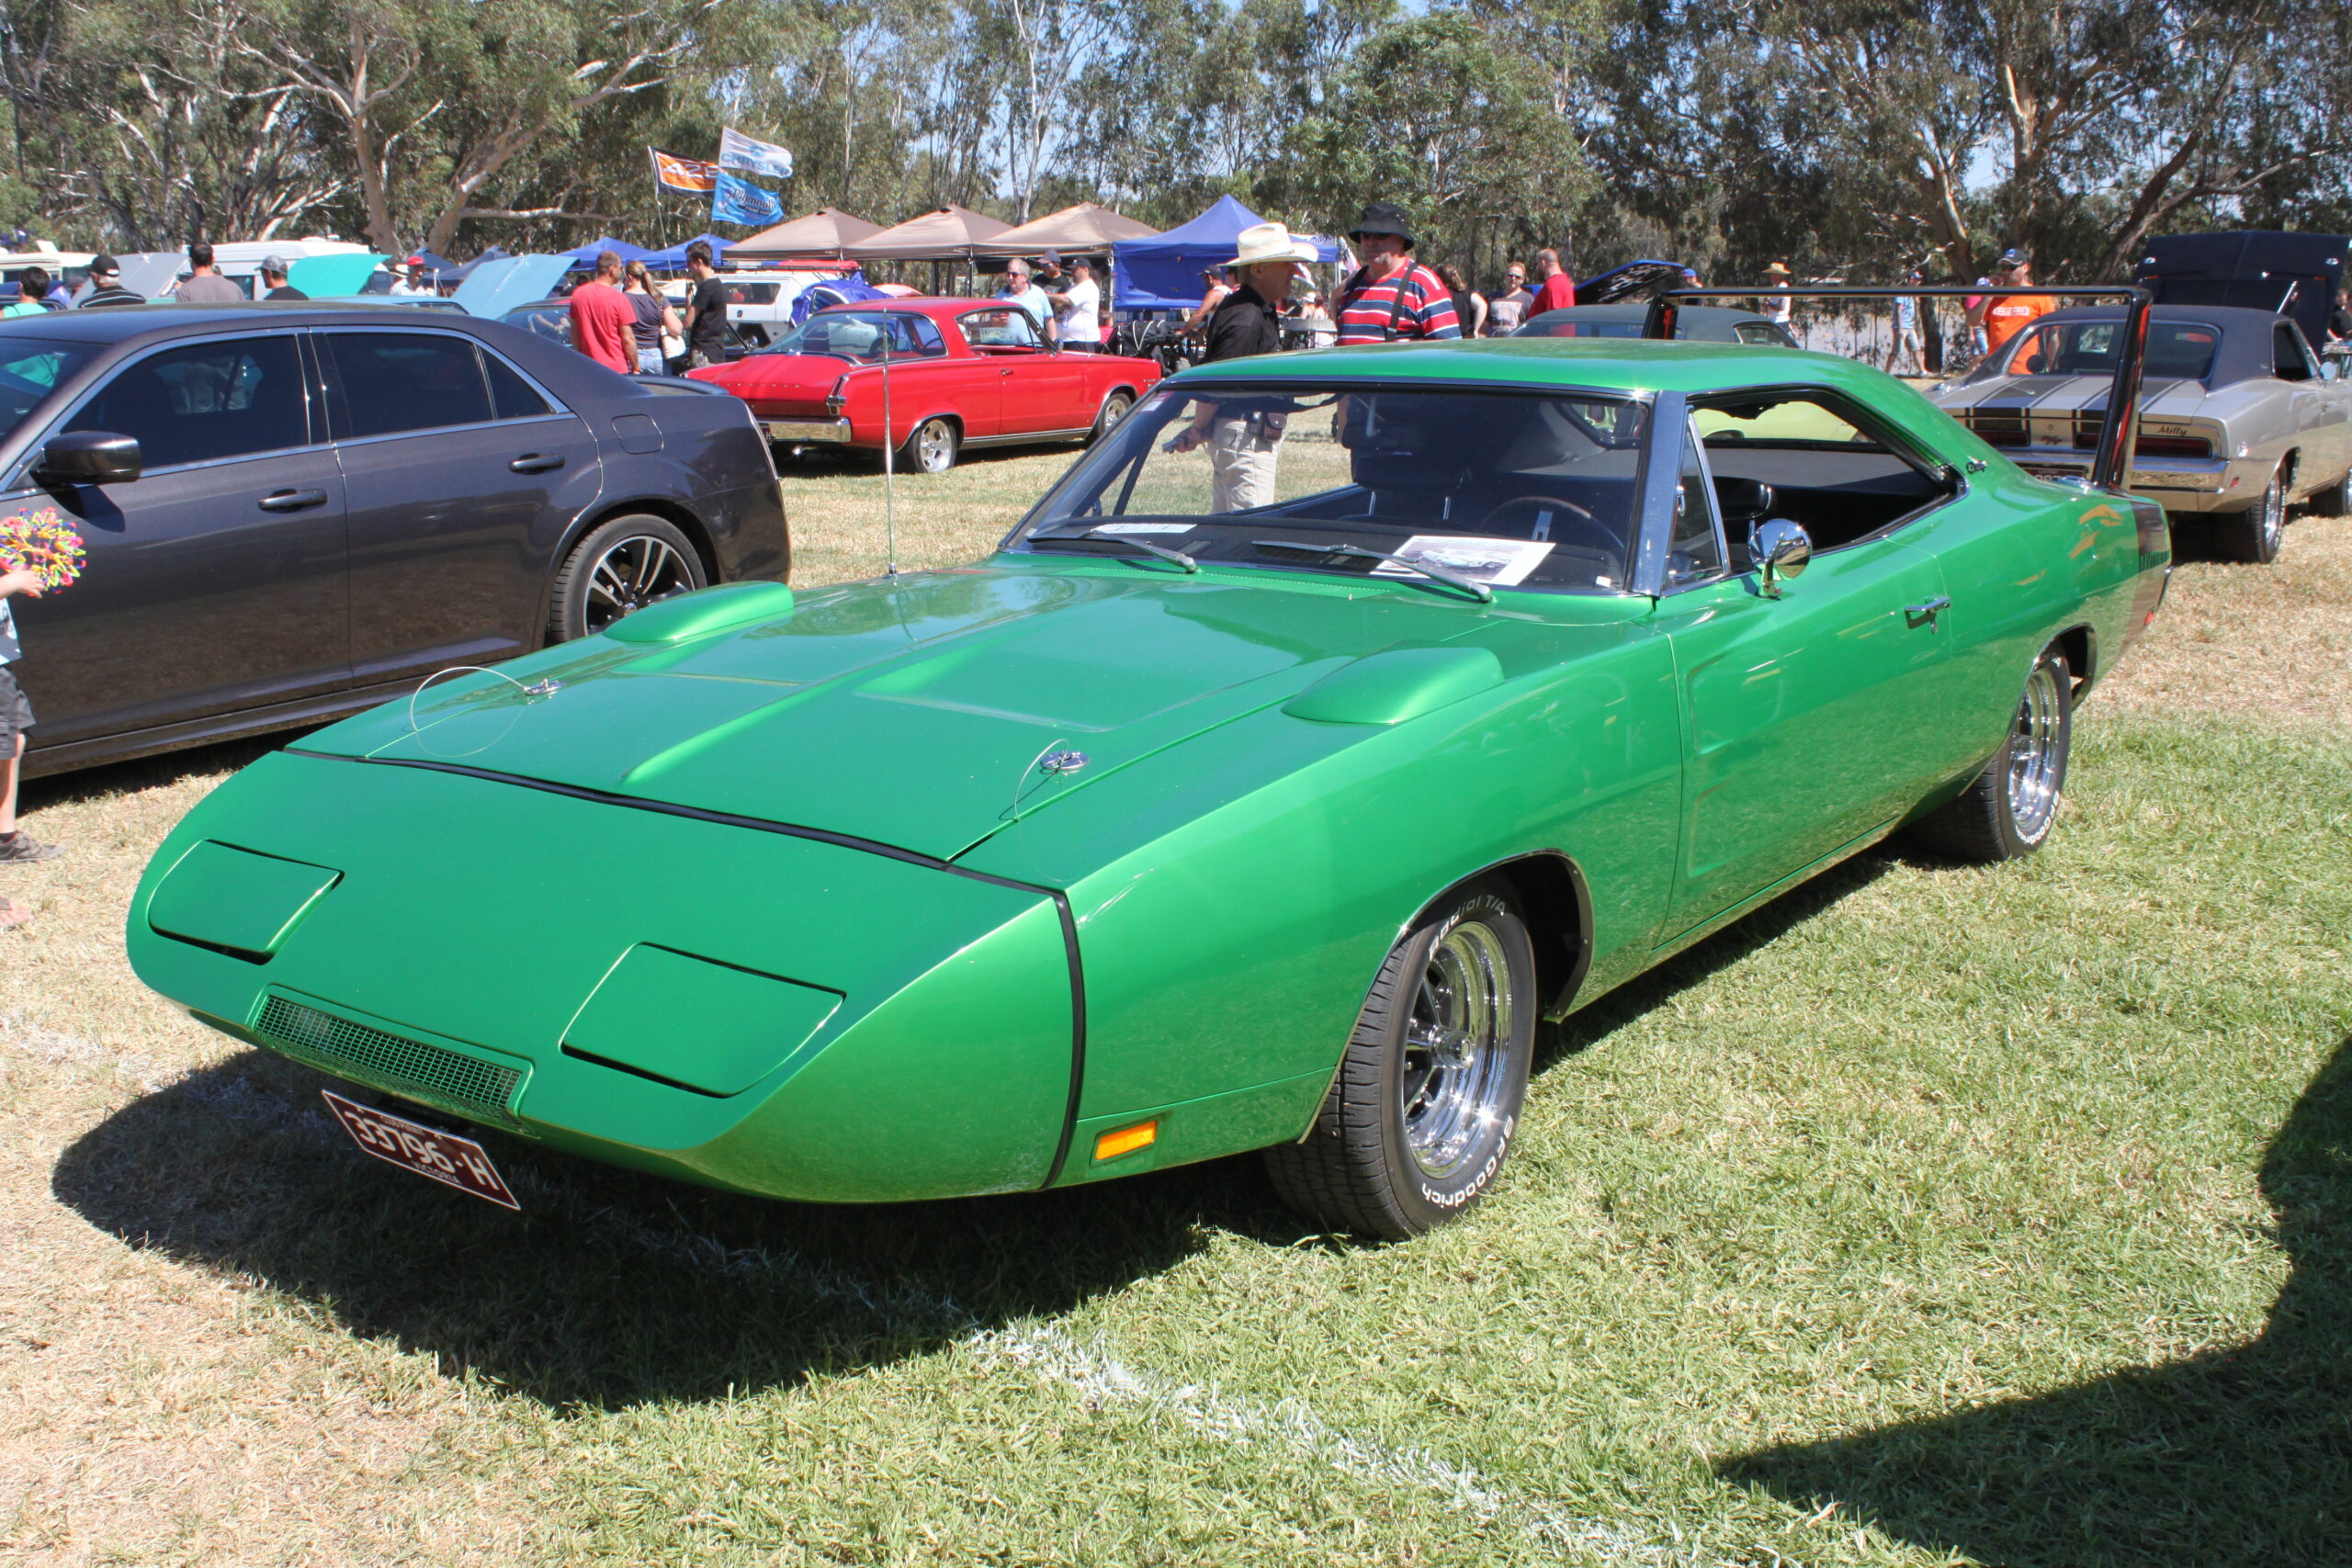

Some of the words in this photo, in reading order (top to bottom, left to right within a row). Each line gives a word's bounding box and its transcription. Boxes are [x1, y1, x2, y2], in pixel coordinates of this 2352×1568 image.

[2157, 425, 2188, 437] Milly
[1429, 895, 1482, 962] Radial
[1485, 895, 1506, 916] T/A
[411, 1160, 462, 1185] VICTORIA
